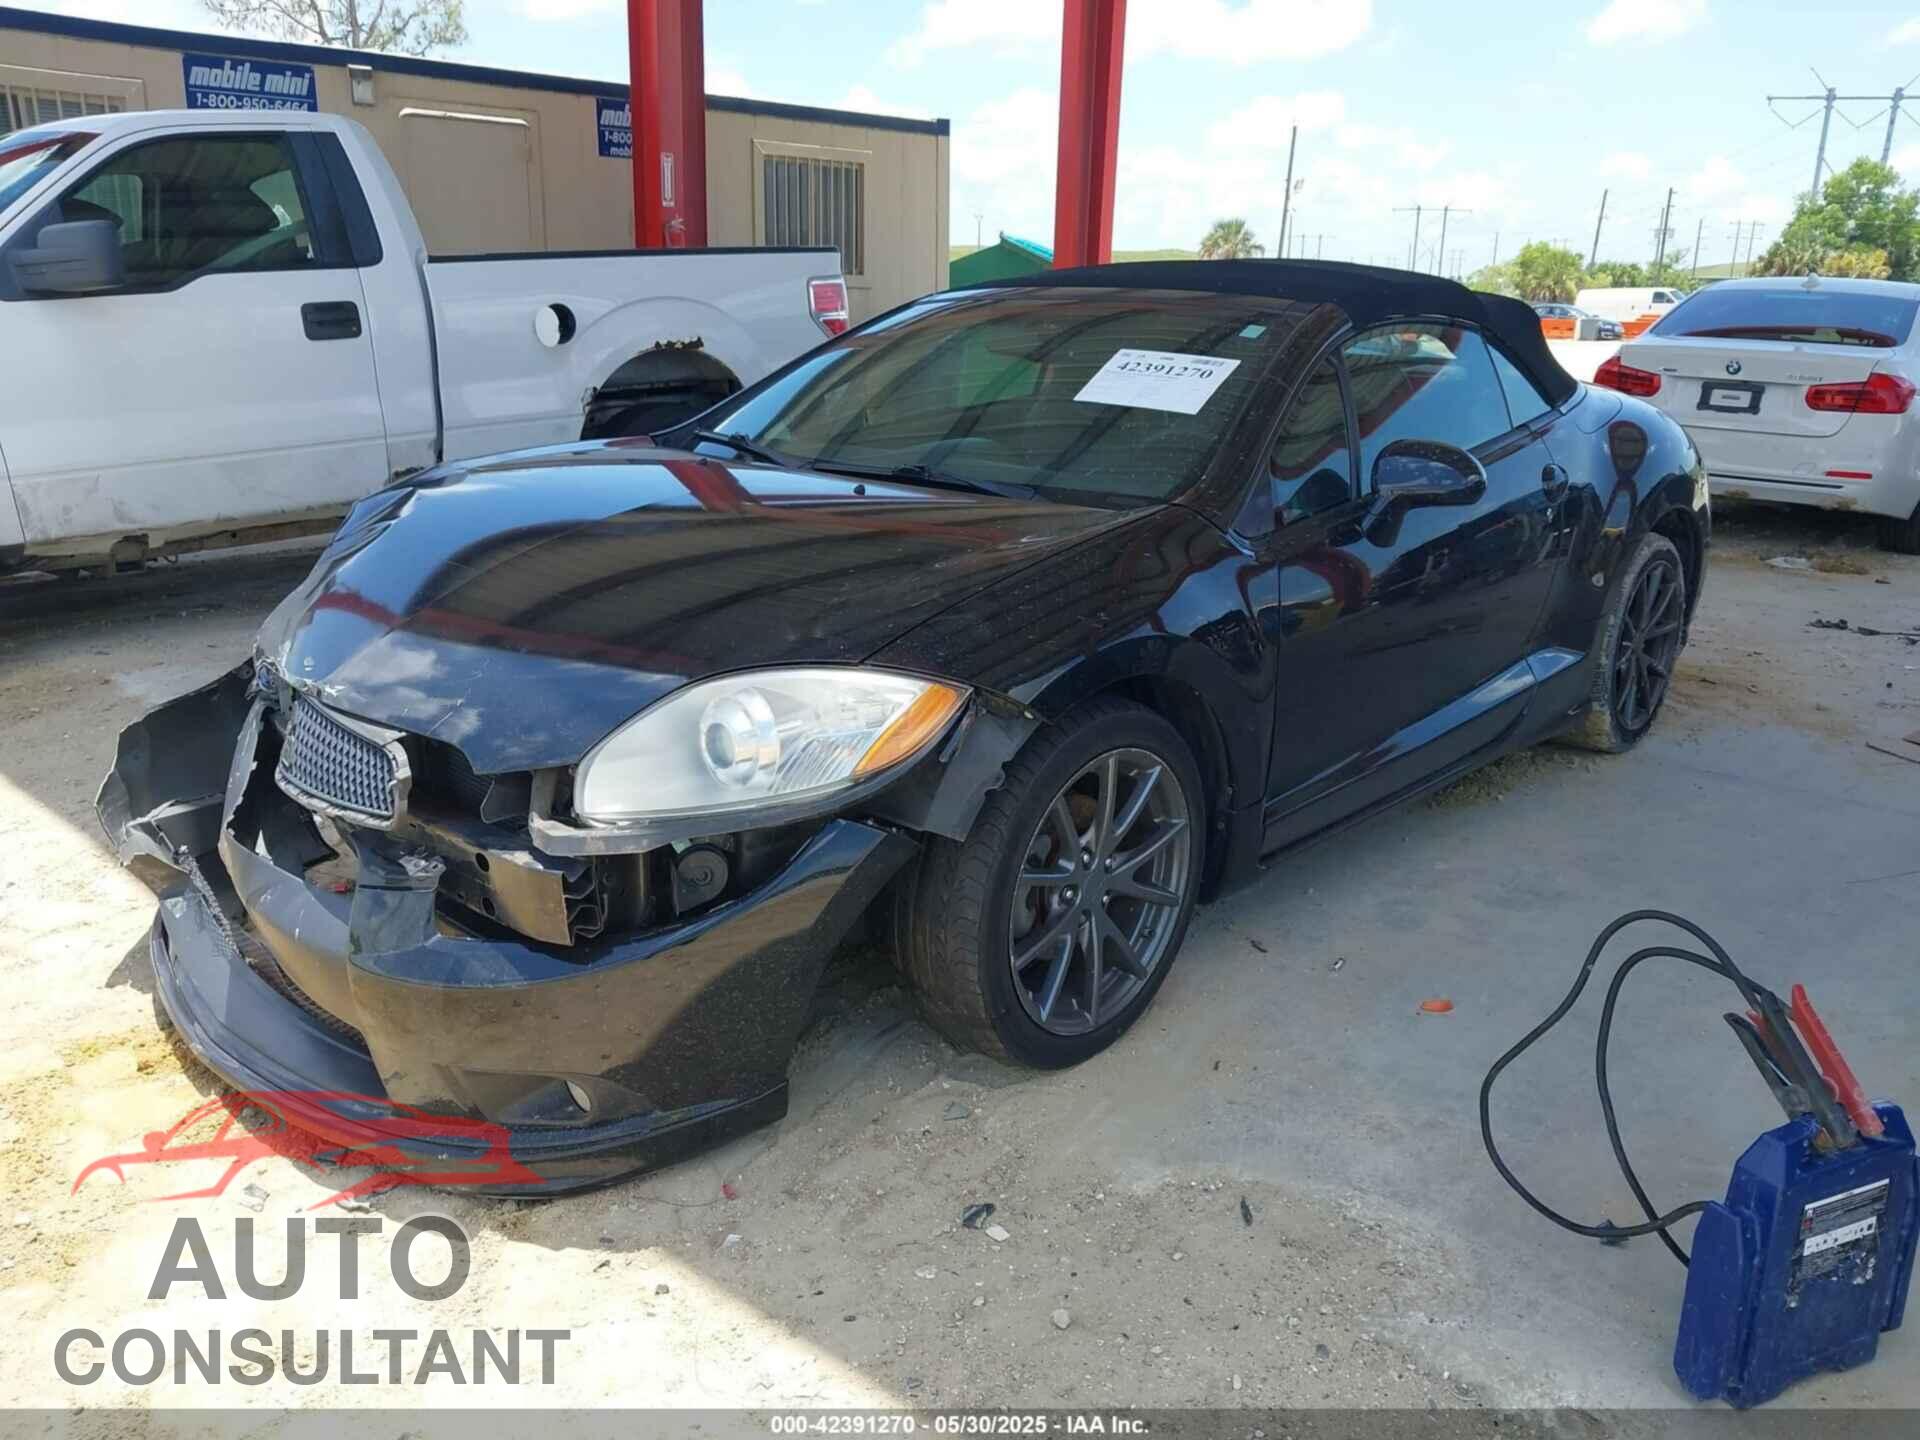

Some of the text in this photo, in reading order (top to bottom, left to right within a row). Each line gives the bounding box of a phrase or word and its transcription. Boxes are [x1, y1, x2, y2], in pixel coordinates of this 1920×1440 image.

[189, 60, 311, 96] mobile mini
[196, 93, 308, 111] 1-800-950-6464
[1118, 362, 1214, 379] 42391270
